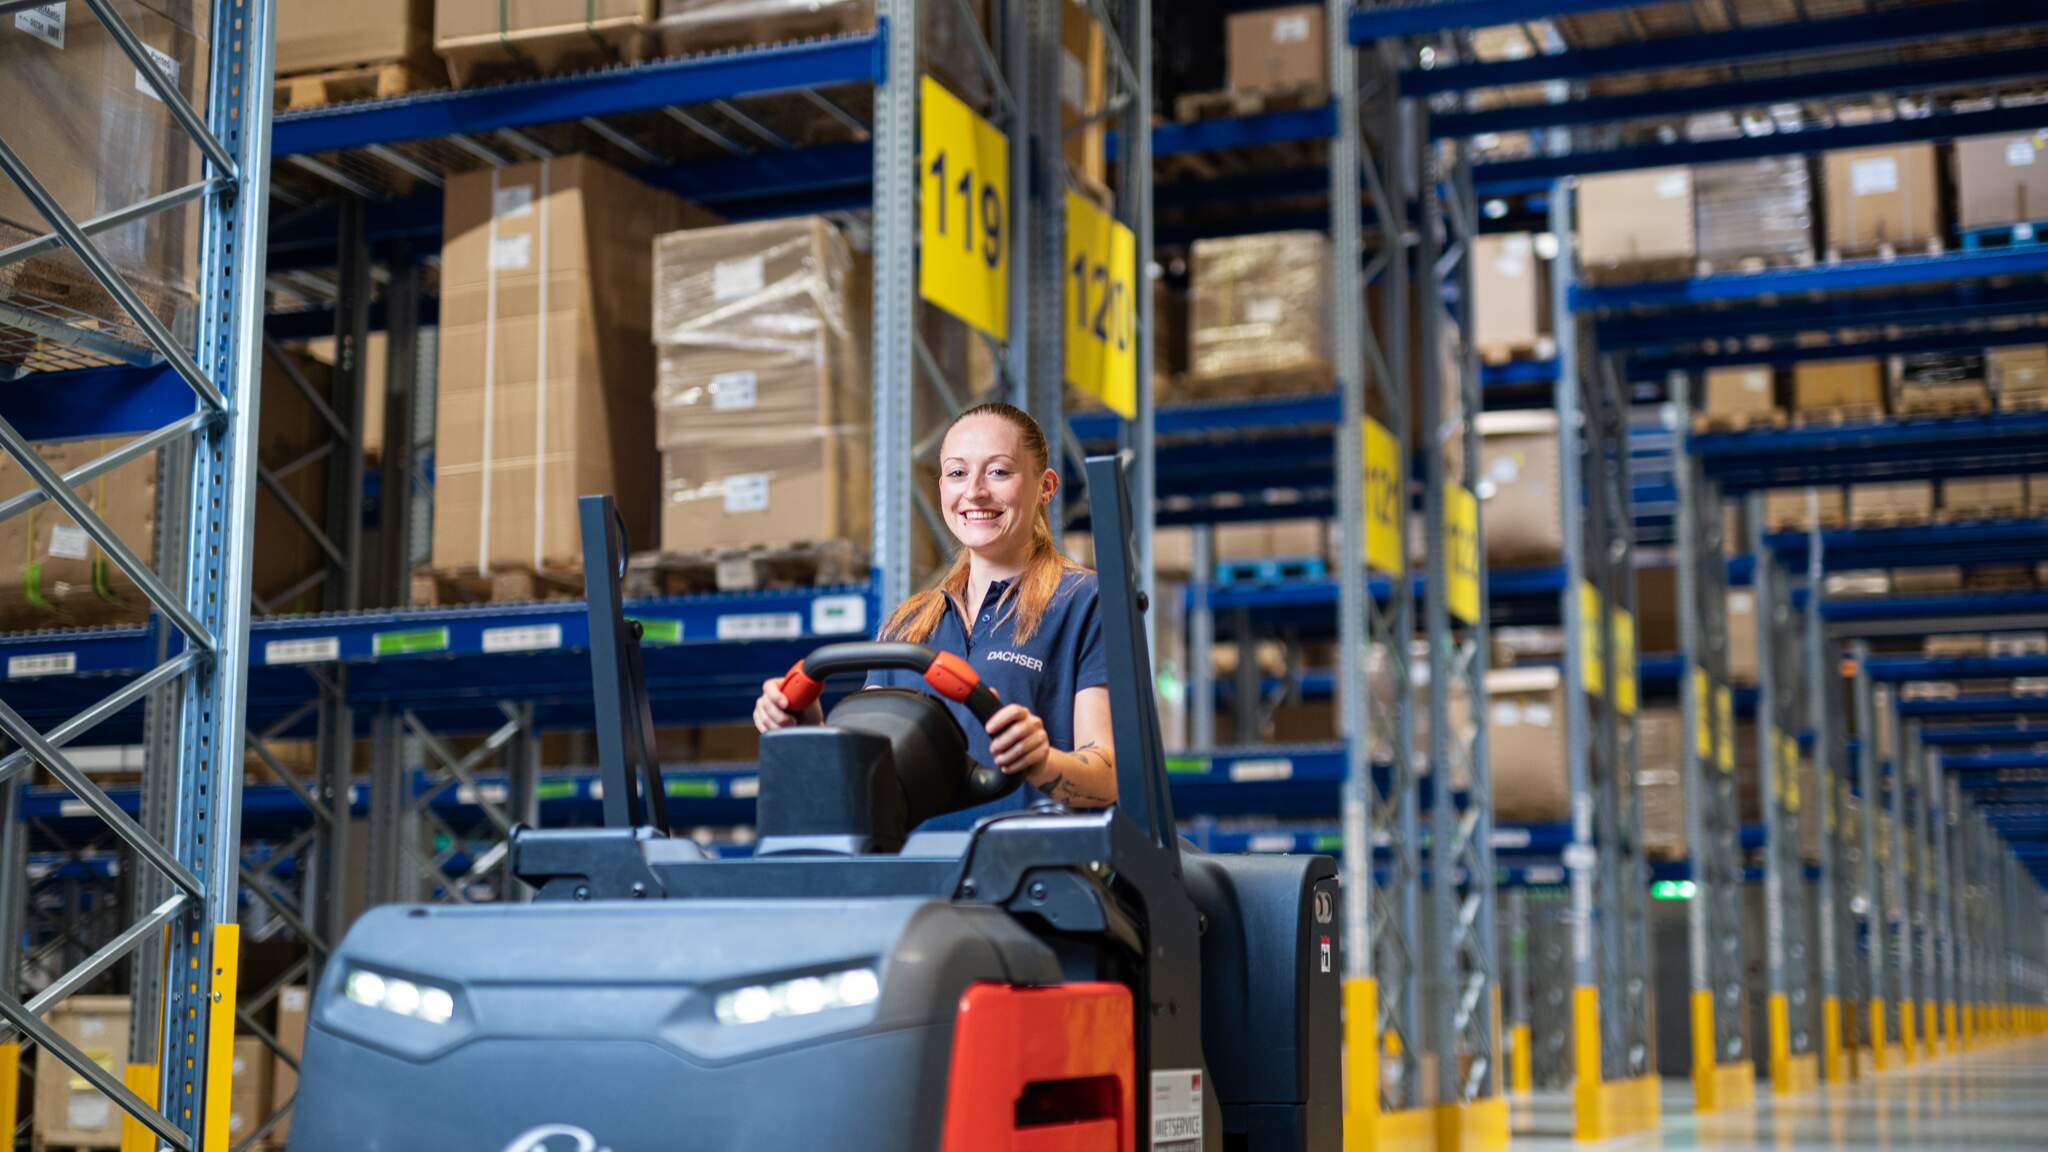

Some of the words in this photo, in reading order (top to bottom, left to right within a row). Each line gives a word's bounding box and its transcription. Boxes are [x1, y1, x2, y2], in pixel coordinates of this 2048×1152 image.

[931, 150, 1000, 269] 119
[1072, 254, 1131, 352] 120
[987, 650, 1043, 673] DACHSER
[1155, 1115, 1200, 1137] MIETSERVICE
